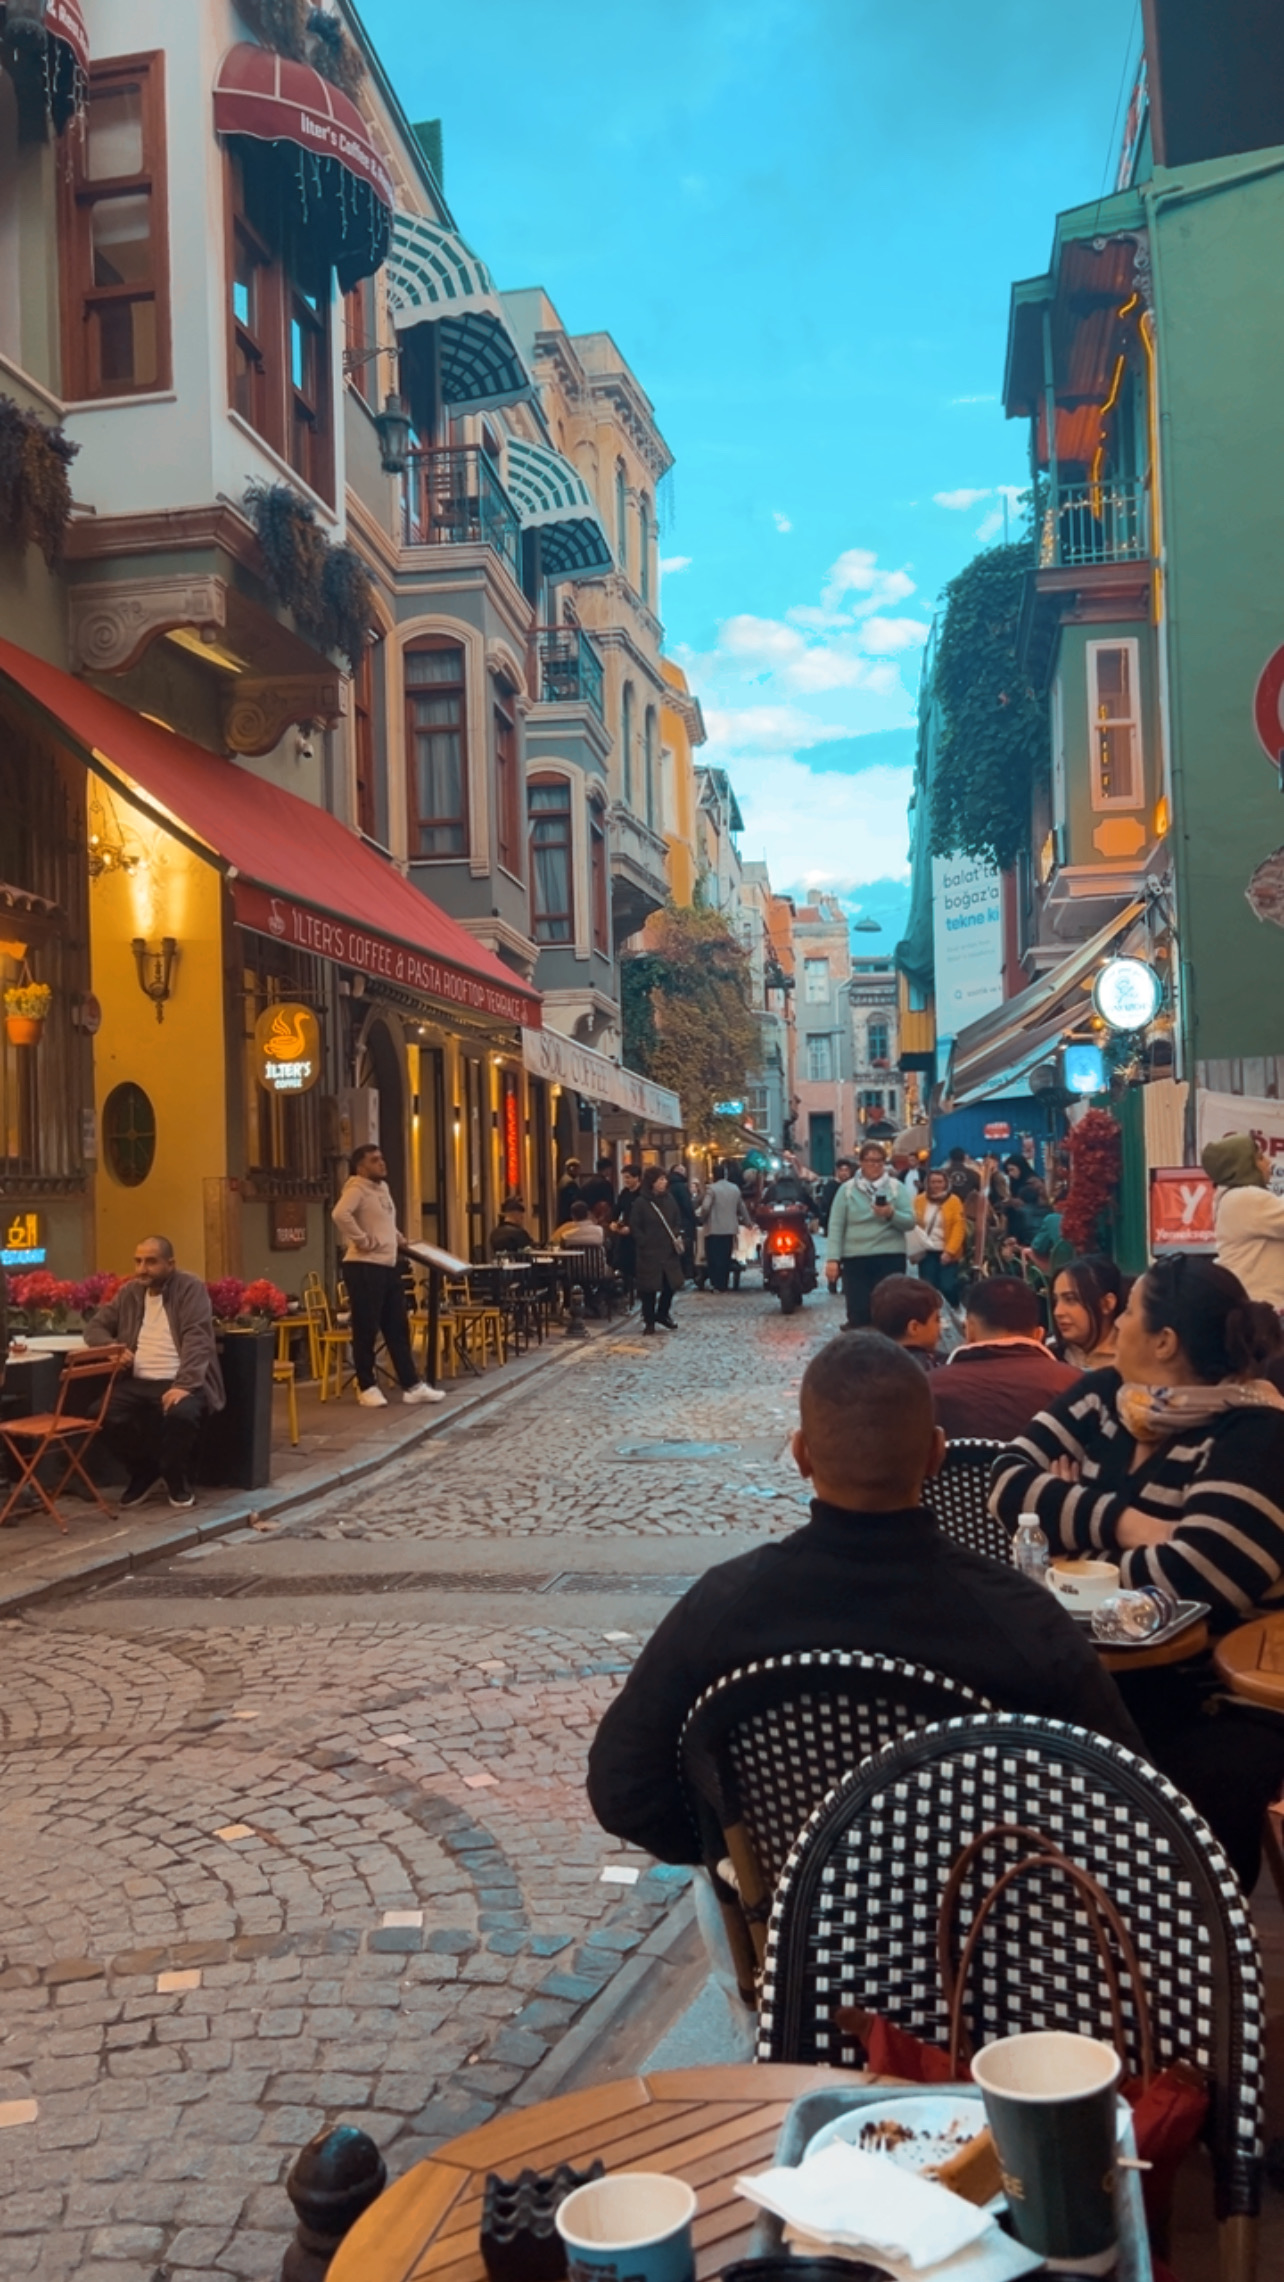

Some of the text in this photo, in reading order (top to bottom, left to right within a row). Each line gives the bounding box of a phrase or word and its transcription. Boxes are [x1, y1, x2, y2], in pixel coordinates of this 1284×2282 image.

[944, 886, 999, 910] boğaz'a
[945, 911, 985, 932] tekne
[349, 934, 392, 975] COFFEE
[395, 953, 405, 979] &
[408, 957, 441, 993] PASTA
[444, 971, 484, 1008] ROOFTOP
[486, 989, 520, 1021] TERRACE
